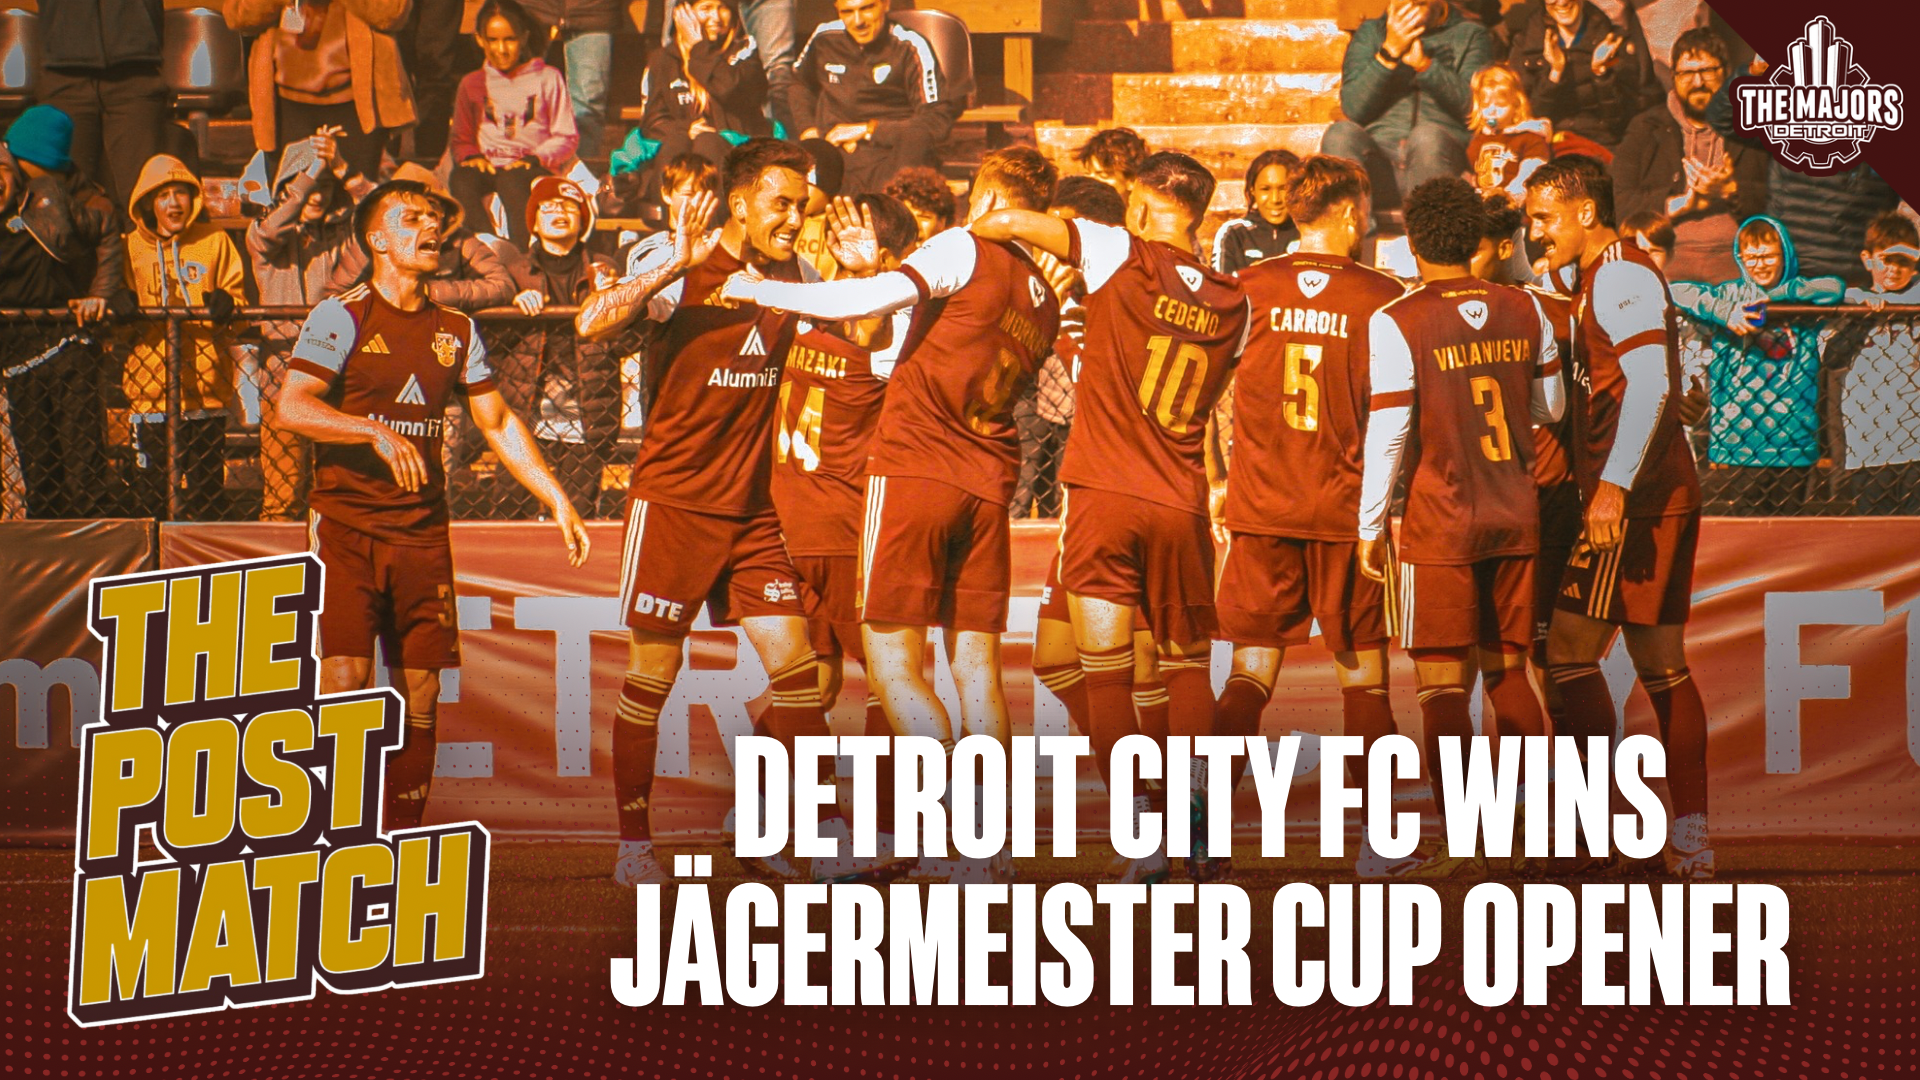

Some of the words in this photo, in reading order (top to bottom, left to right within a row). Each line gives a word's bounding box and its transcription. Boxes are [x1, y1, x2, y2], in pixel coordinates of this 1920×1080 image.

[1153, 294, 1219, 337] CEDEÑO
[1270, 307, 1348, 339] CARROLL
[785, 344, 848, 380] MAZAKI
[1433, 338, 1531, 372] VILLANUEVA
[1137, 335, 1209, 434] 10
[1282, 342, 1323, 432] 5
[777, 380, 826, 472] 14
[1469, 375, 1511, 462] 3
[634, 592, 684, 622] DTE
